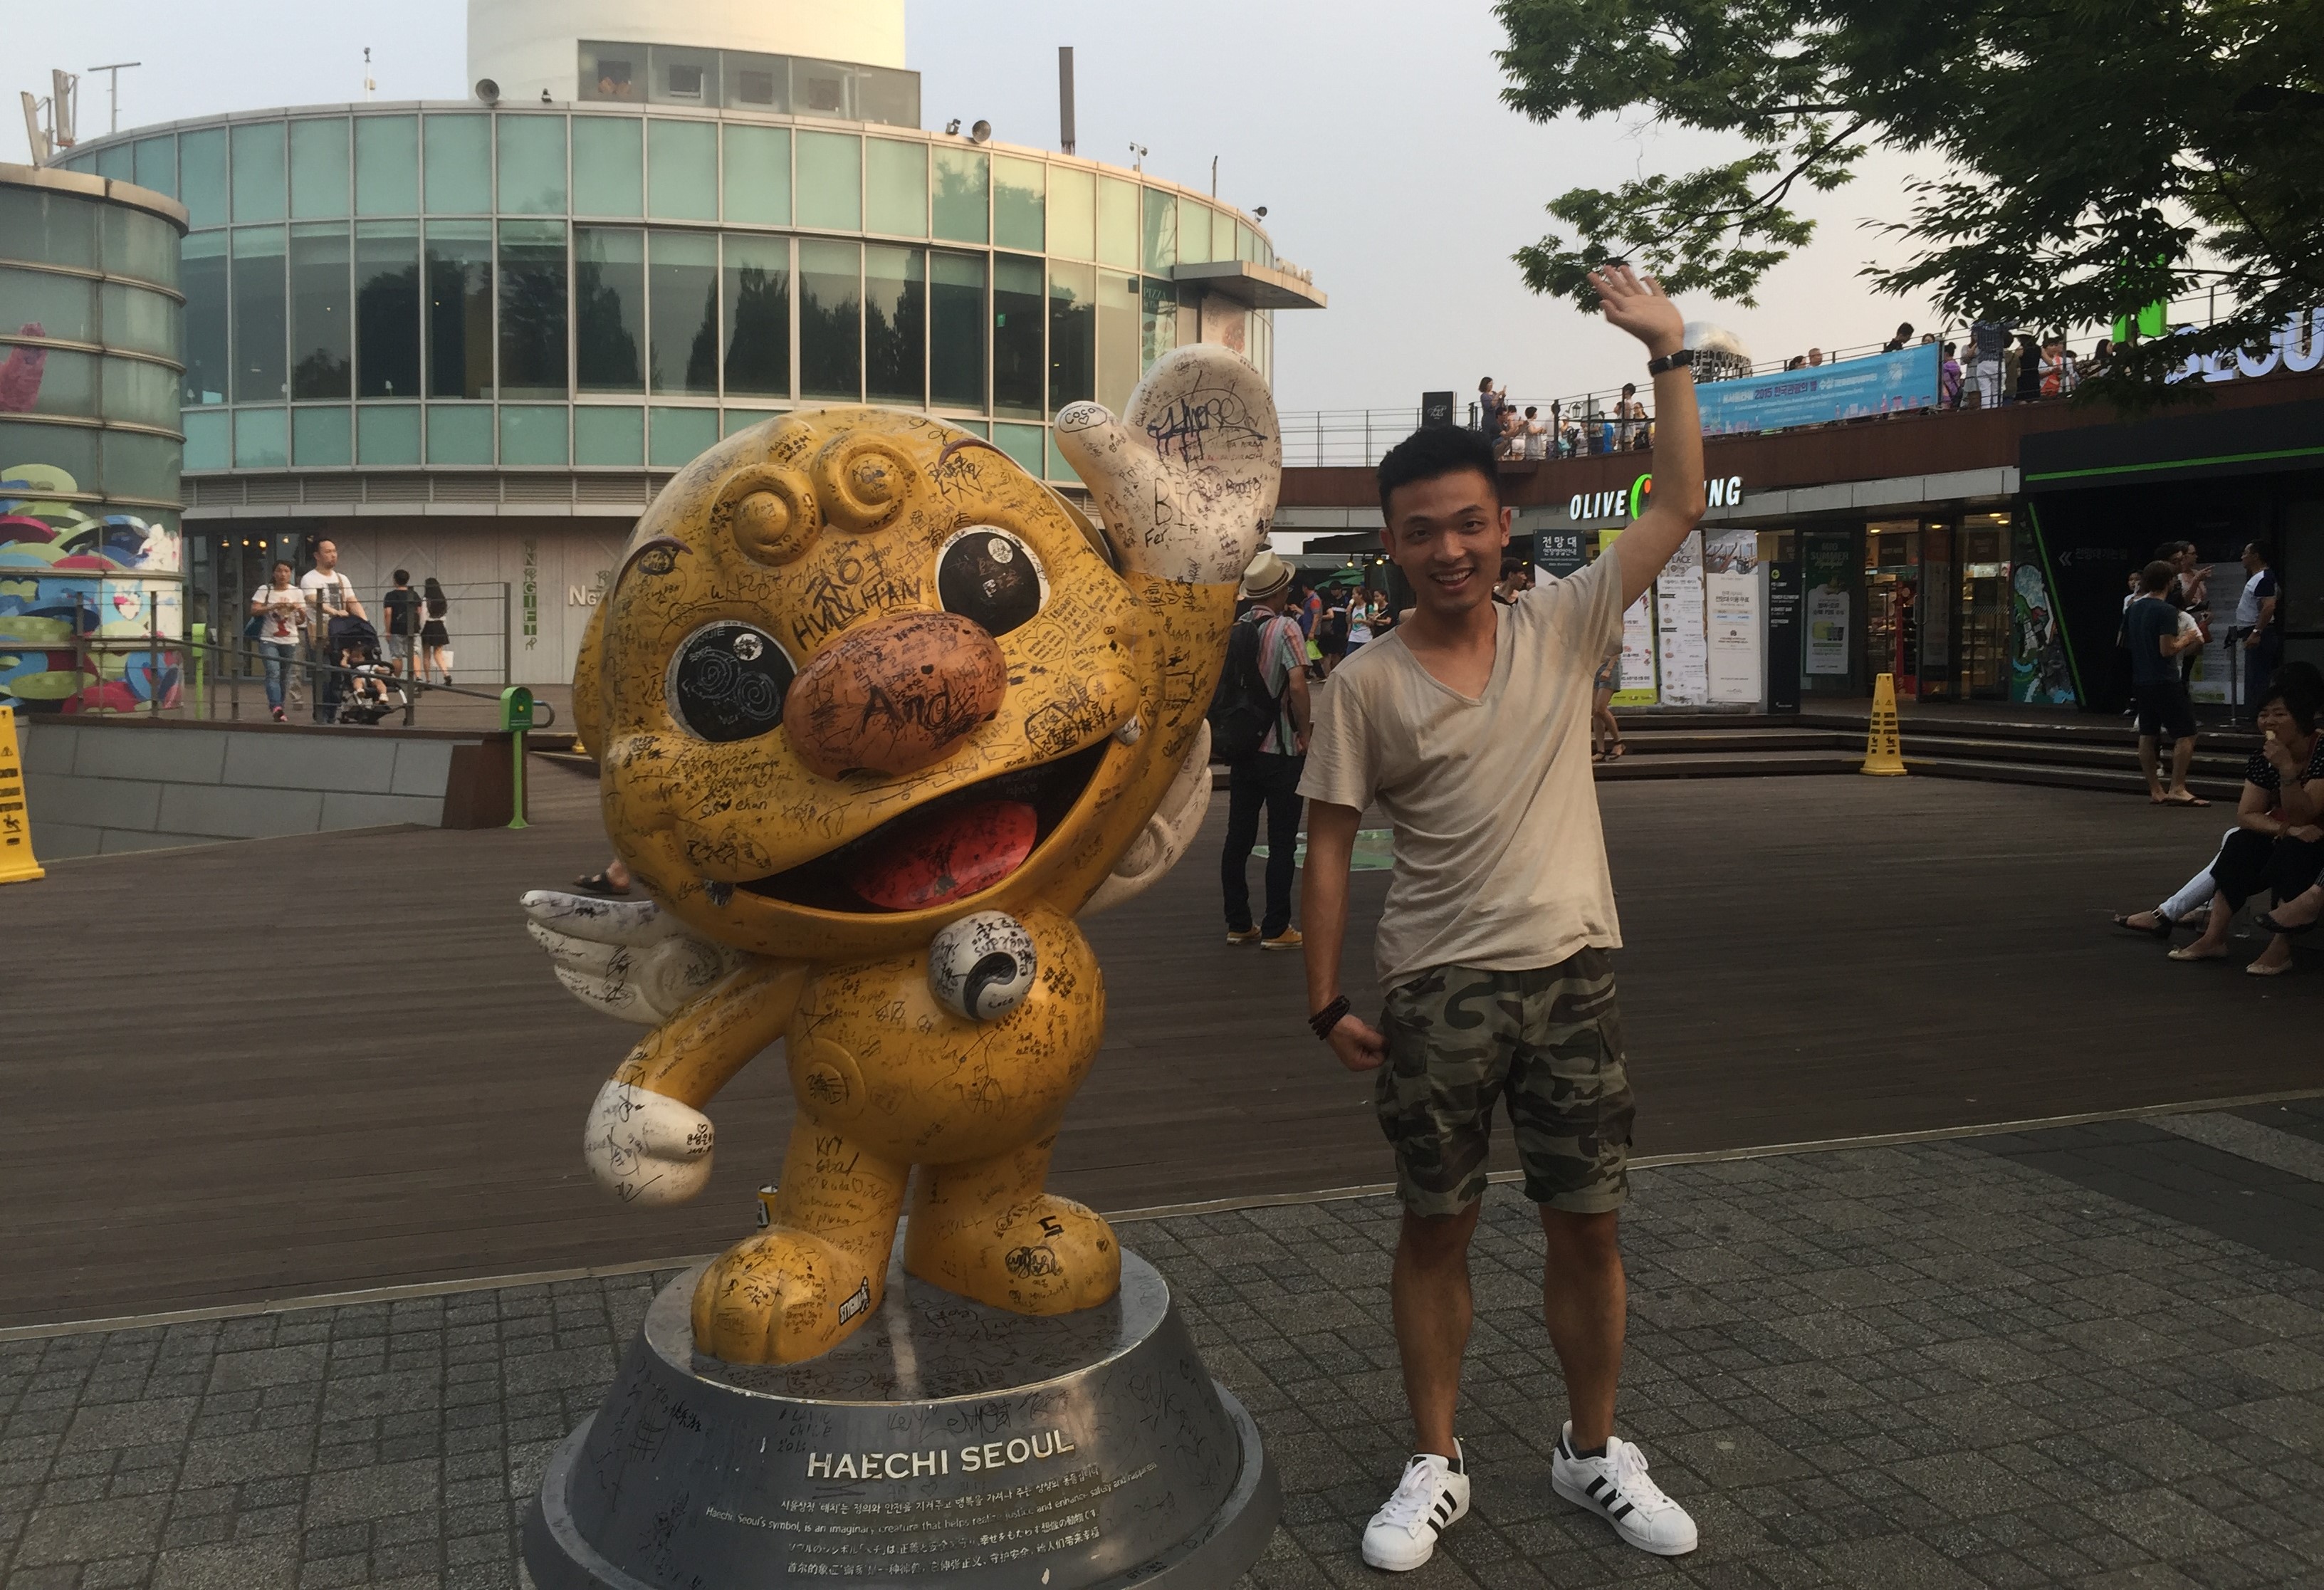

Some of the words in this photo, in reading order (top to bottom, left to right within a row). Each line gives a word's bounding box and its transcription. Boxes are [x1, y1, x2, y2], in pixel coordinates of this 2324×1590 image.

[1569, 489, 1628, 521] OLIVE
[1542, 535, 1577, 548] 전망대
[524, 582, 537, 636] GIFT
[807, 1449, 949, 1480] HAECHI
[961, 1428, 1076, 1473] SEOUL
[737, 1514, 766, 1527] Seoul's
[768, 1520, 801, 1533] symbol,
[805, 1522, 812, 1532] is
[815, 1524, 827, 1533] an
[878, 1522, 918, 1534] creature
[922, 1520, 941, 1532] that
[944, 1517, 970, 1529] helps
[1004, 1506, 1035, 1522] justice
[1036, 1499, 1053, 1514] and
[1113, 1475, 1126, 1488] and
[854, 1502, 881, 1515] 정의와
[884, 1501, 911, 1515] 안전을
[916, 1499, 952, 1512] 지켜주고
[1016, 1485, 1032, 1498] 주는
[1035, 1480, 1059, 1494] 상상의
